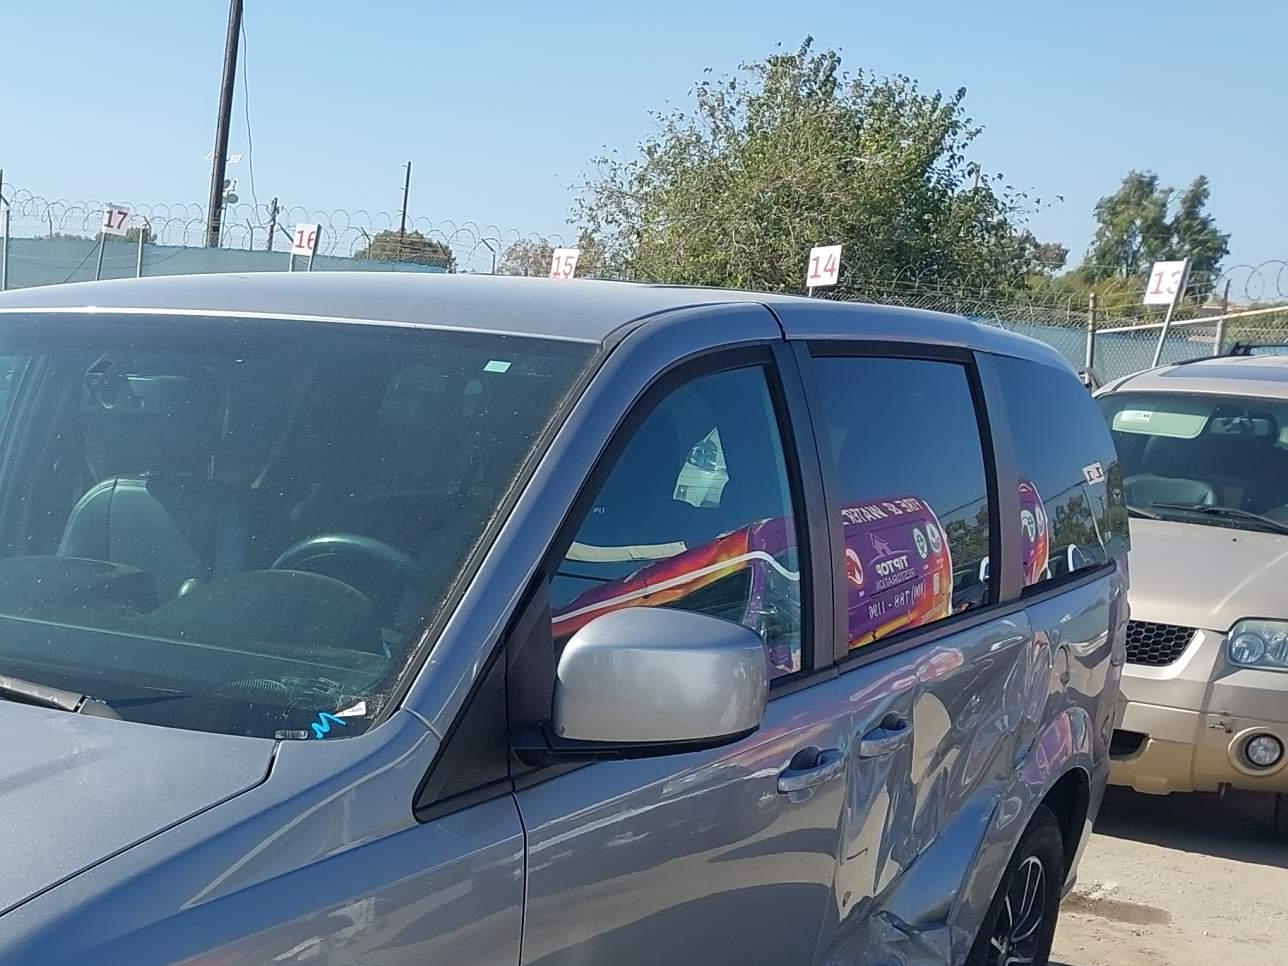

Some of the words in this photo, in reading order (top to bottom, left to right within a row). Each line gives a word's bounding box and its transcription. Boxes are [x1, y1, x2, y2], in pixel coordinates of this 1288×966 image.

[103, 209, 129, 230] 17
[294, 229, 317, 250] 16
[552, 255, 575, 277] 15
[809, 252, 837, 279] 14
